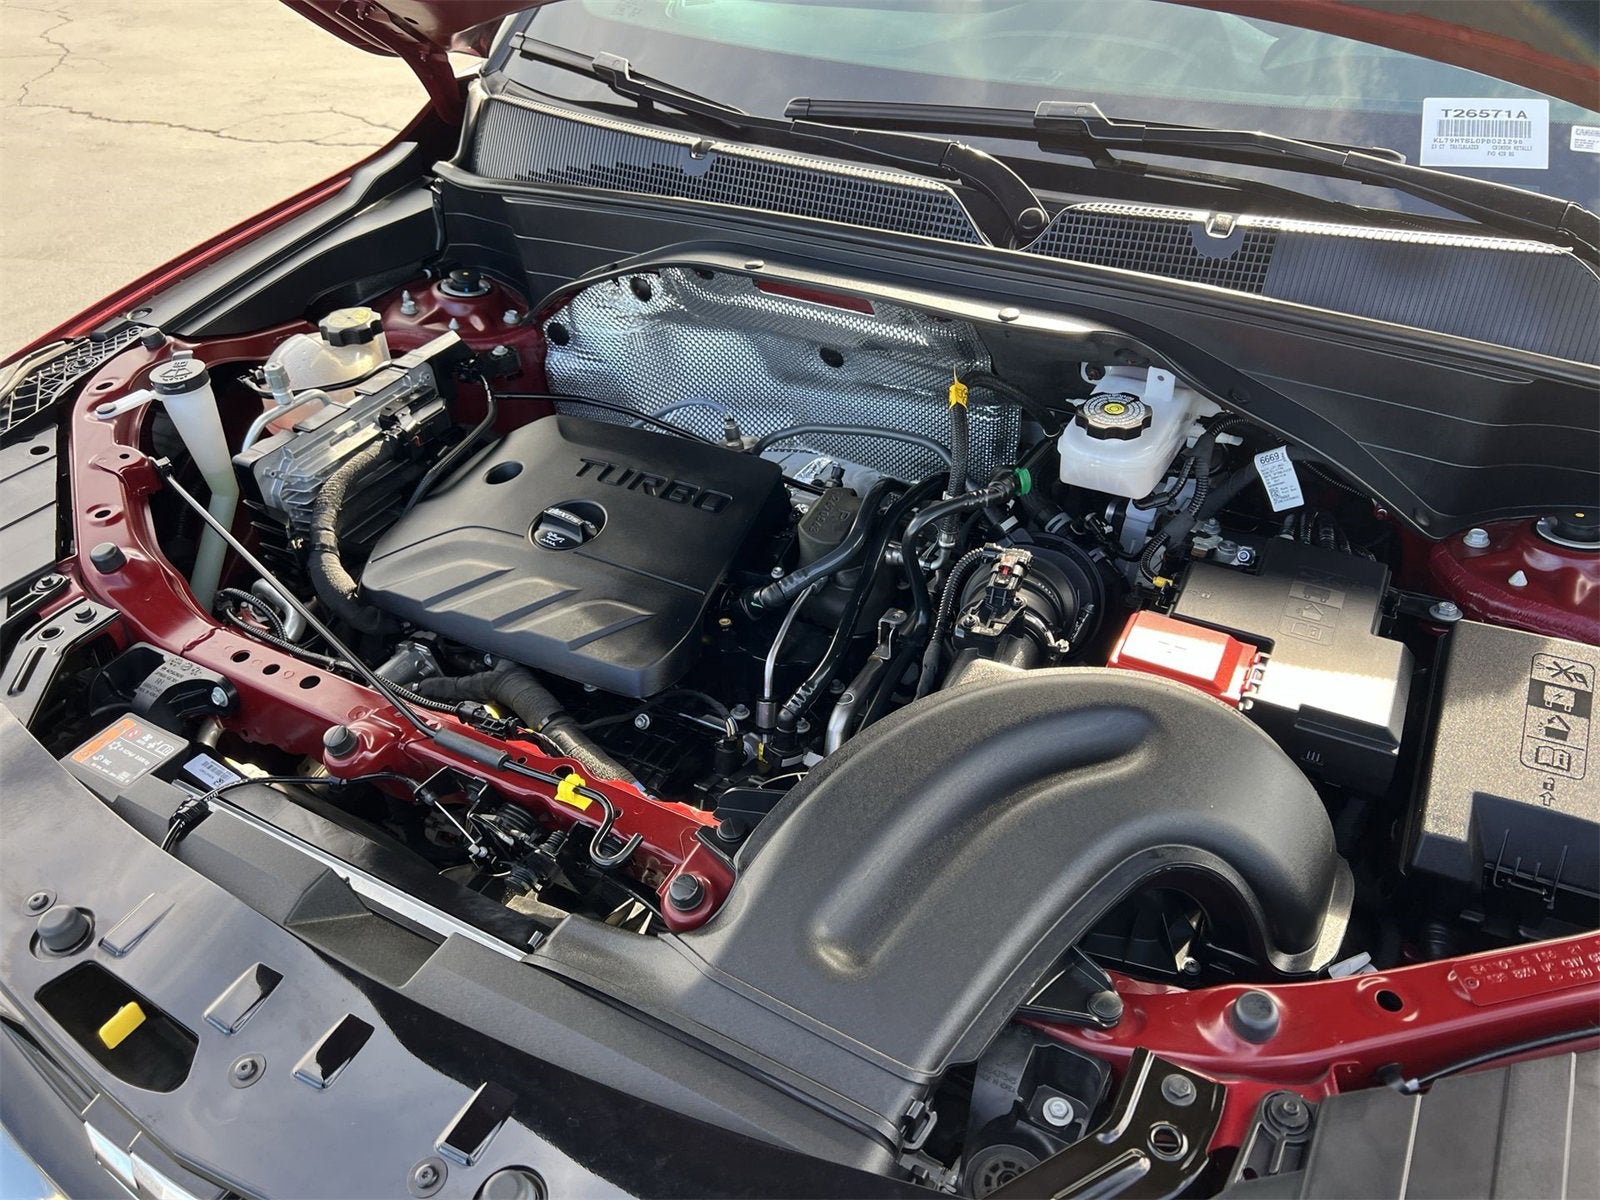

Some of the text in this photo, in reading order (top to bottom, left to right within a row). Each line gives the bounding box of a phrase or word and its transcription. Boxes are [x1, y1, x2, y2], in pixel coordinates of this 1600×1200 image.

[1441, 109, 1528, 119] T26571A
[1260, 452, 1280, 464] 6669
[575, 457, 734, 514] TURBO
